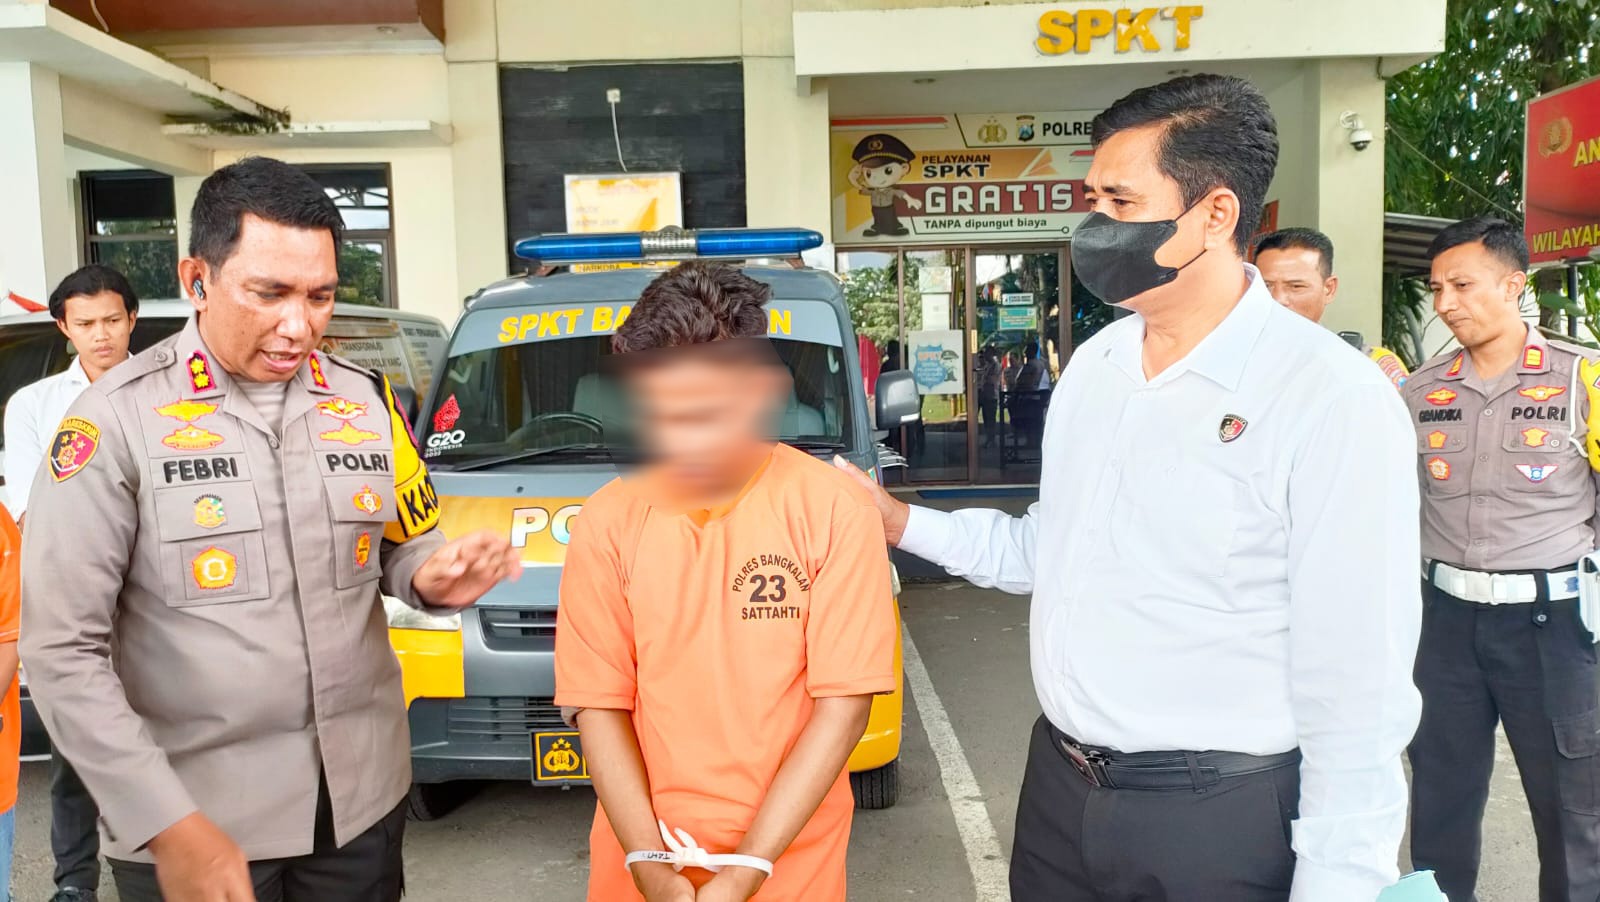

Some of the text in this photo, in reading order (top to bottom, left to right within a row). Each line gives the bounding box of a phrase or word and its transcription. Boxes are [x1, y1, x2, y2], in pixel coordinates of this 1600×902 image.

[1036, 6, 1203, 54] SPKT
[1042, 121, 1093, 136] POLRE
[922, 154, 991, 164] PELAYANAN
[923, 164, 990, 178] SPKT
[924, 217, 1047, 231] TANPA dipungut biaya
[1532, 223, 1600, 254] WILAYAH
[497, 307, 584, 343] SPKT
[1511, 406, 1567, 421] POLRI
[163, 457, 239, 483] FEBRI
[326, 453, 389, 472] POLRI
[732, 554, 809, 592] POLRES BANGKALAN
[749, 574, 787, 603] 23
[741, 606, 800, 620] SATTAHTI
